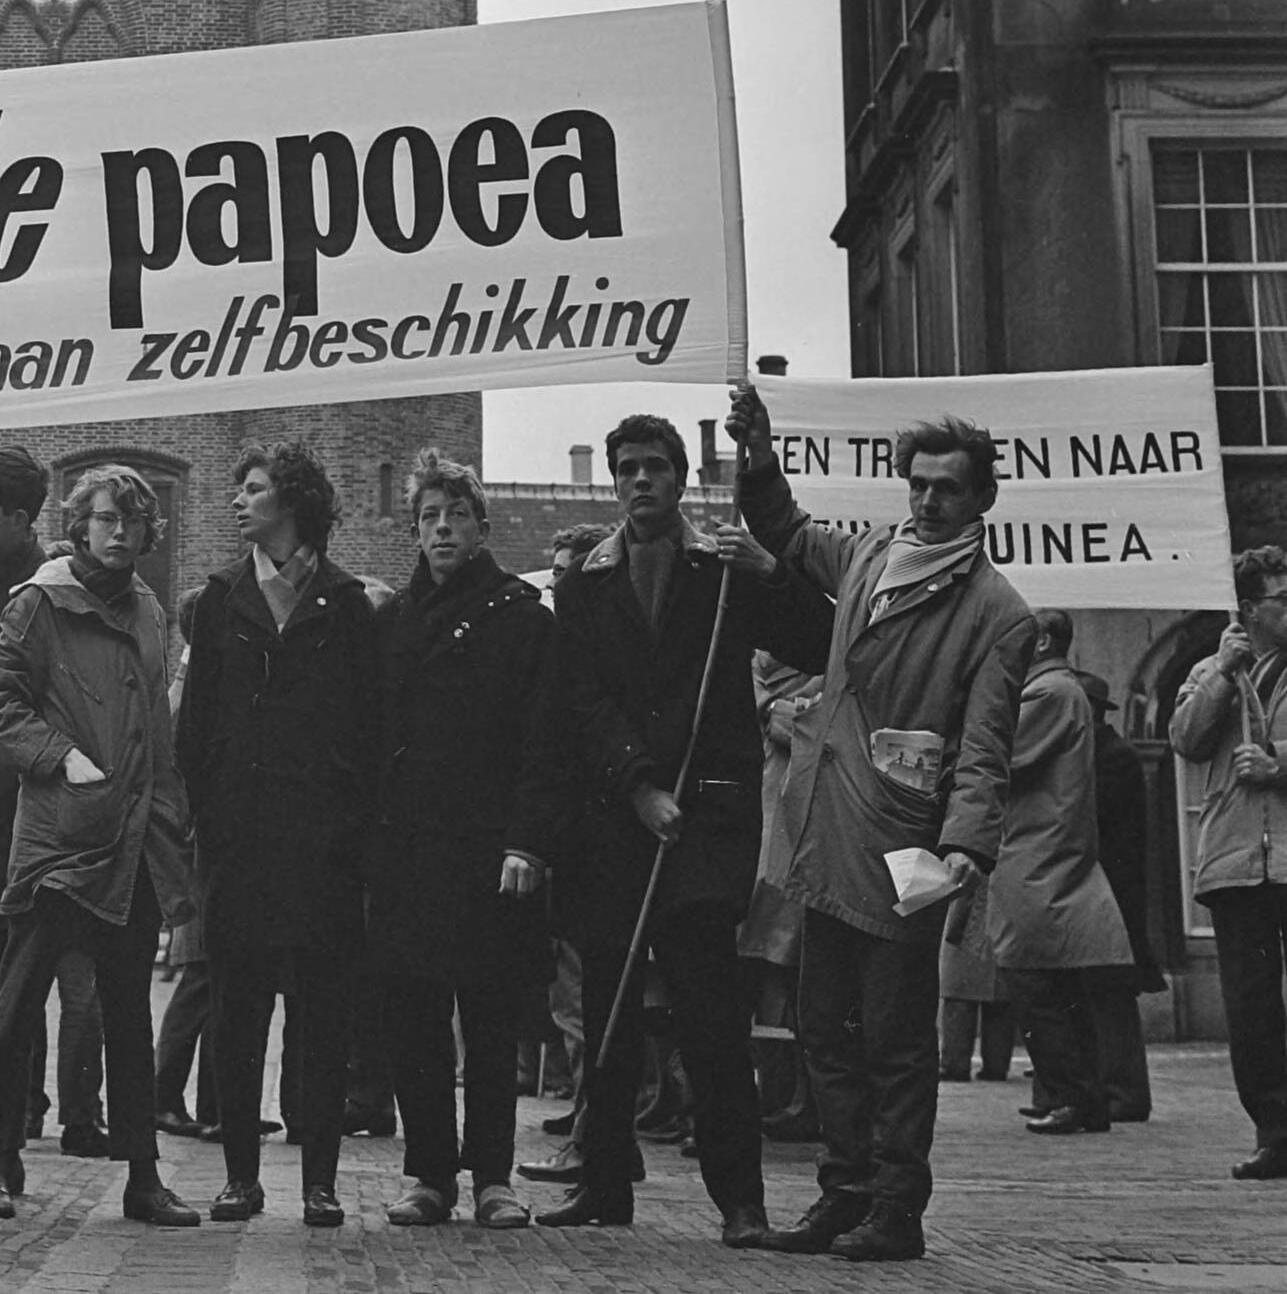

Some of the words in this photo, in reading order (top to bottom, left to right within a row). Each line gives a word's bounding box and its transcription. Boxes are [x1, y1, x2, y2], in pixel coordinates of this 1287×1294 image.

[100, 109, 623, 330] papoea
[126, 274, 690, 382] zelfbeschikking
[1069, 430, 1203, 478] NAAR
